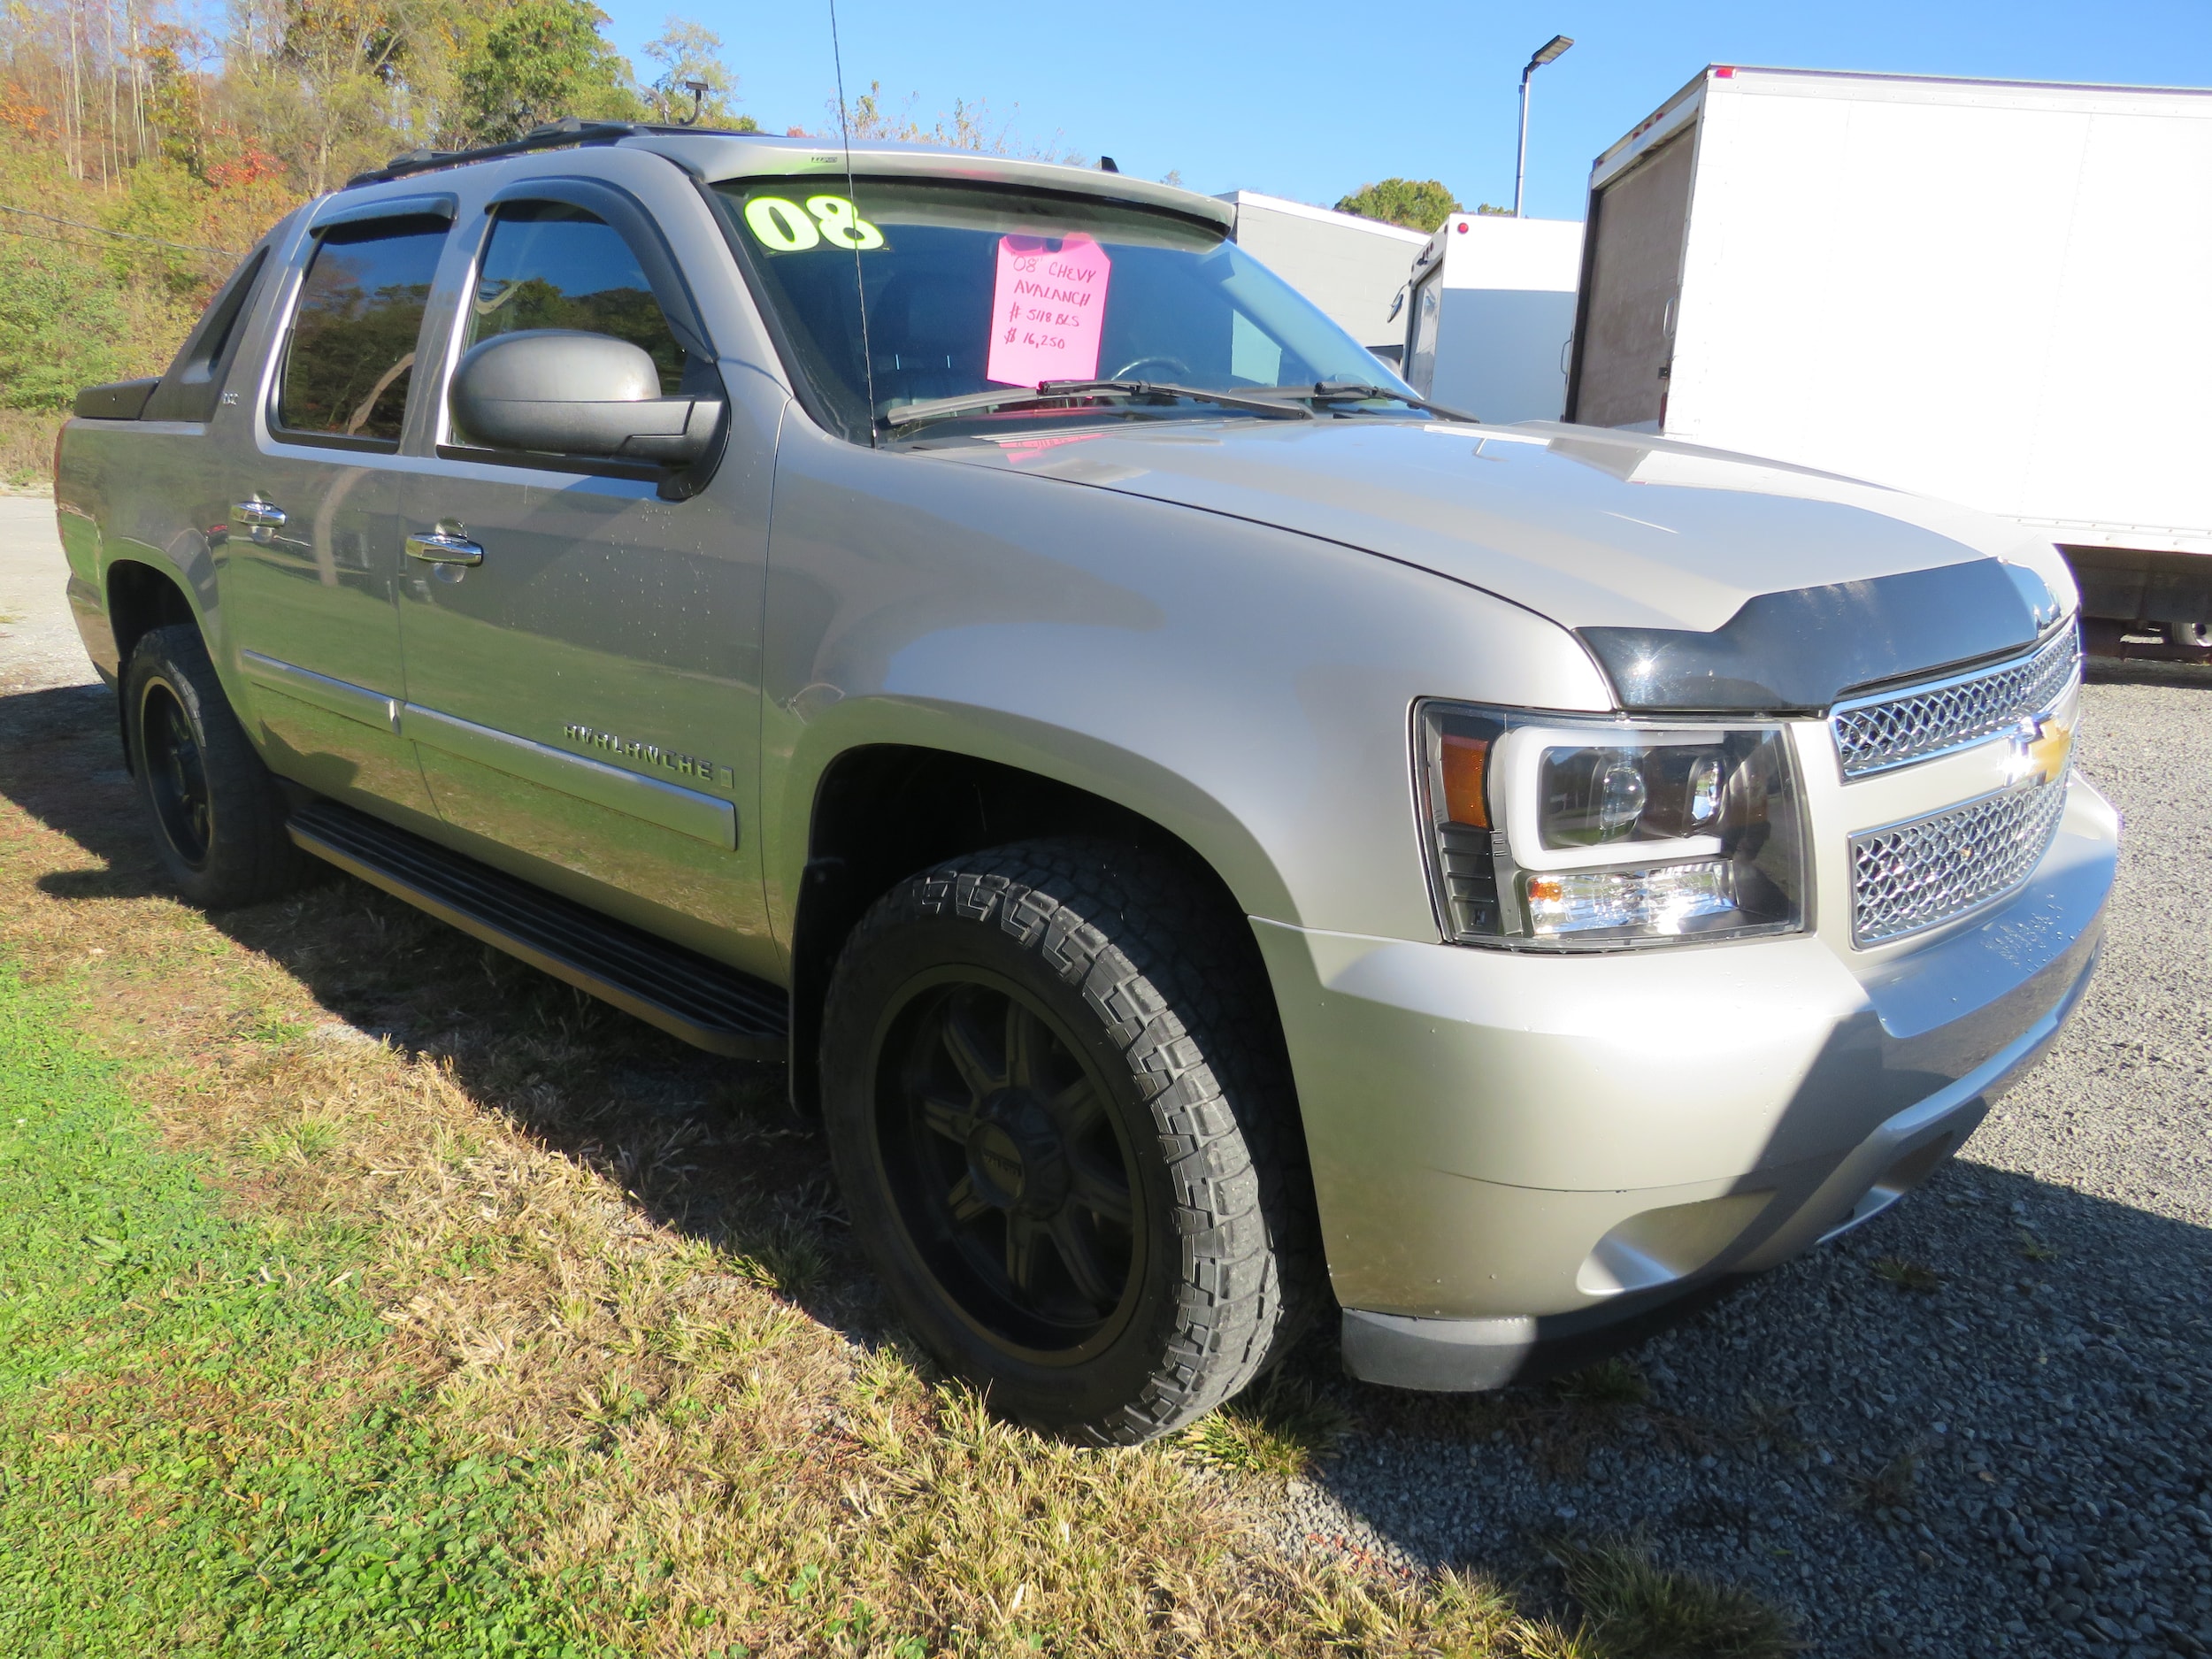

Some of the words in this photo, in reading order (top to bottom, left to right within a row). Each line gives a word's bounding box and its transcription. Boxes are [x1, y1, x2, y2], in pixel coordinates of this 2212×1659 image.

[744, 195, 884, 251] 08
[1048, 262, 1096, 283] CHEVY
[1014, 280, 1091, 307] AVALANCH
[1026, 309, 1052, 322] 5118
[1023, 333, 1065, 349] 16,250
[564, 722, 713, 781] AVALANCHE
